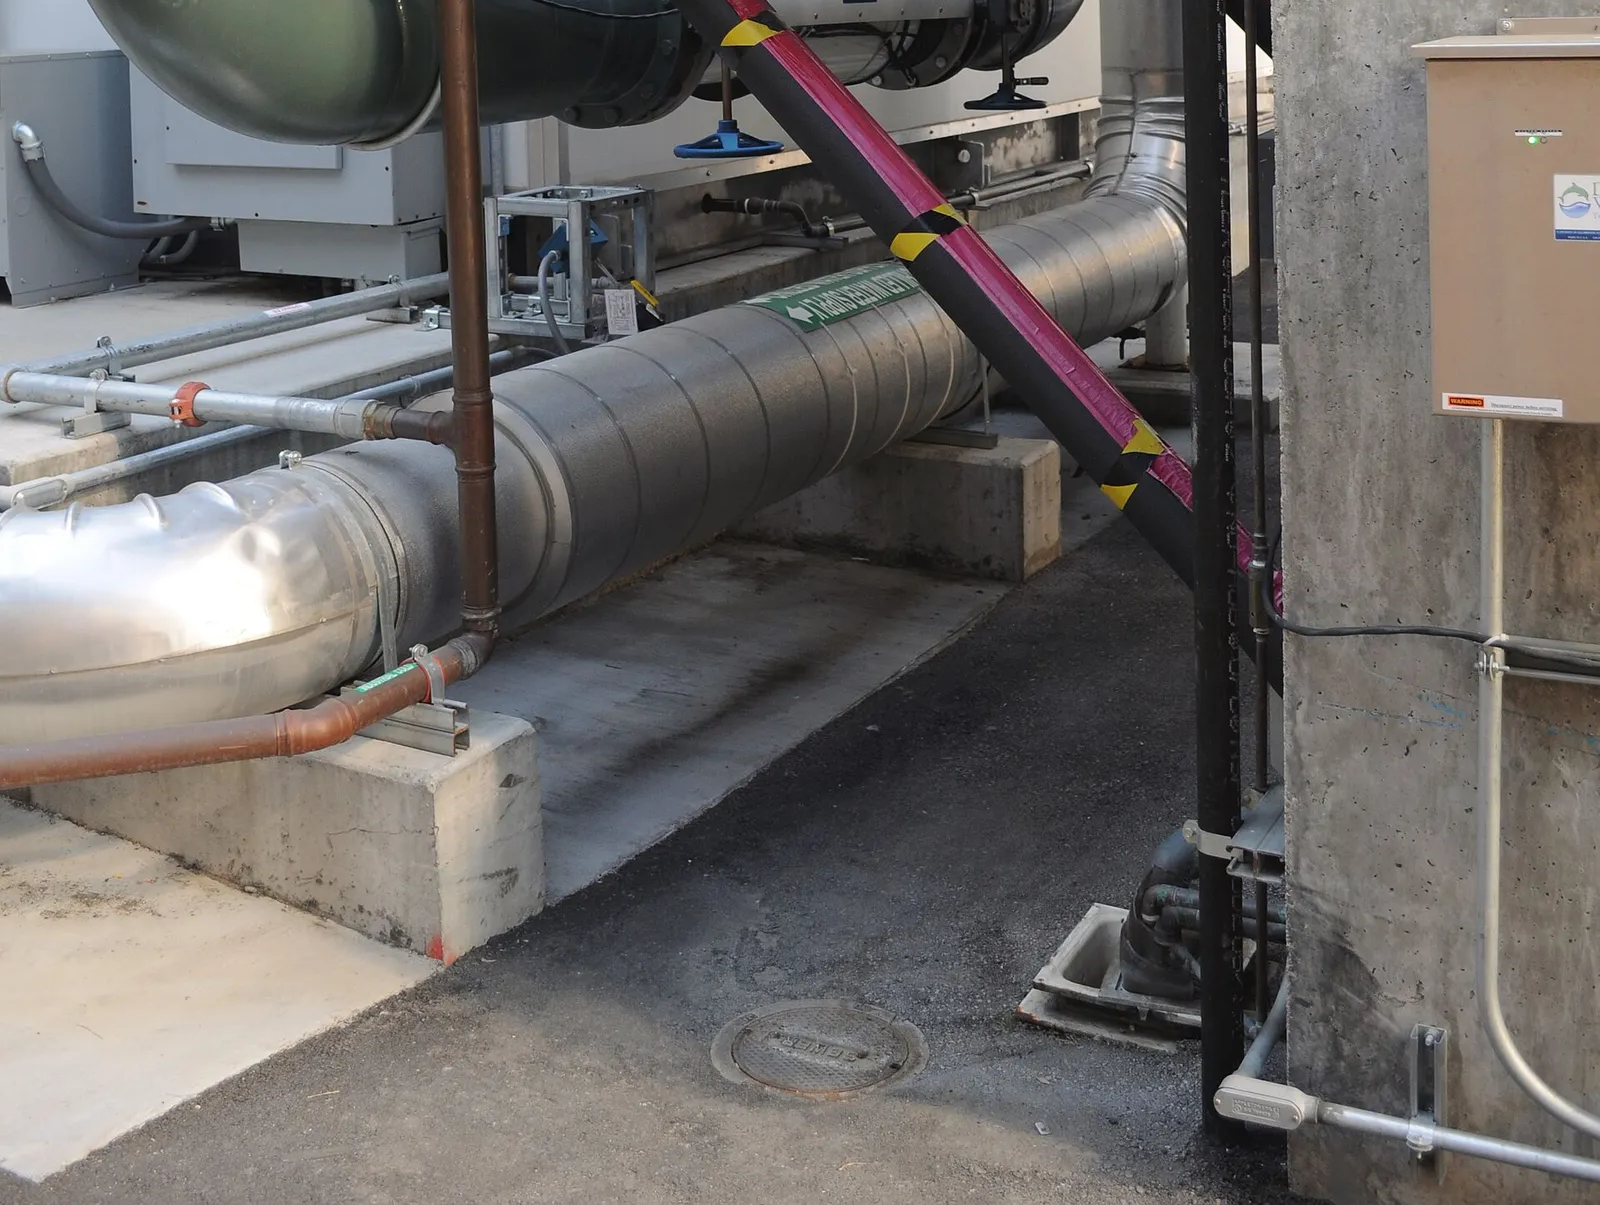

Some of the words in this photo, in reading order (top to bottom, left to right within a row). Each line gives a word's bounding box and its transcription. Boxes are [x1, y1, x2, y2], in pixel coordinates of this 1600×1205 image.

[835, 280, 892, 305] WATER
[799, 290, 858, 321] SUPPLY
[1450, 397, 1483, 406] WARNING
[780, 1037, 857, 1063] SEWER
